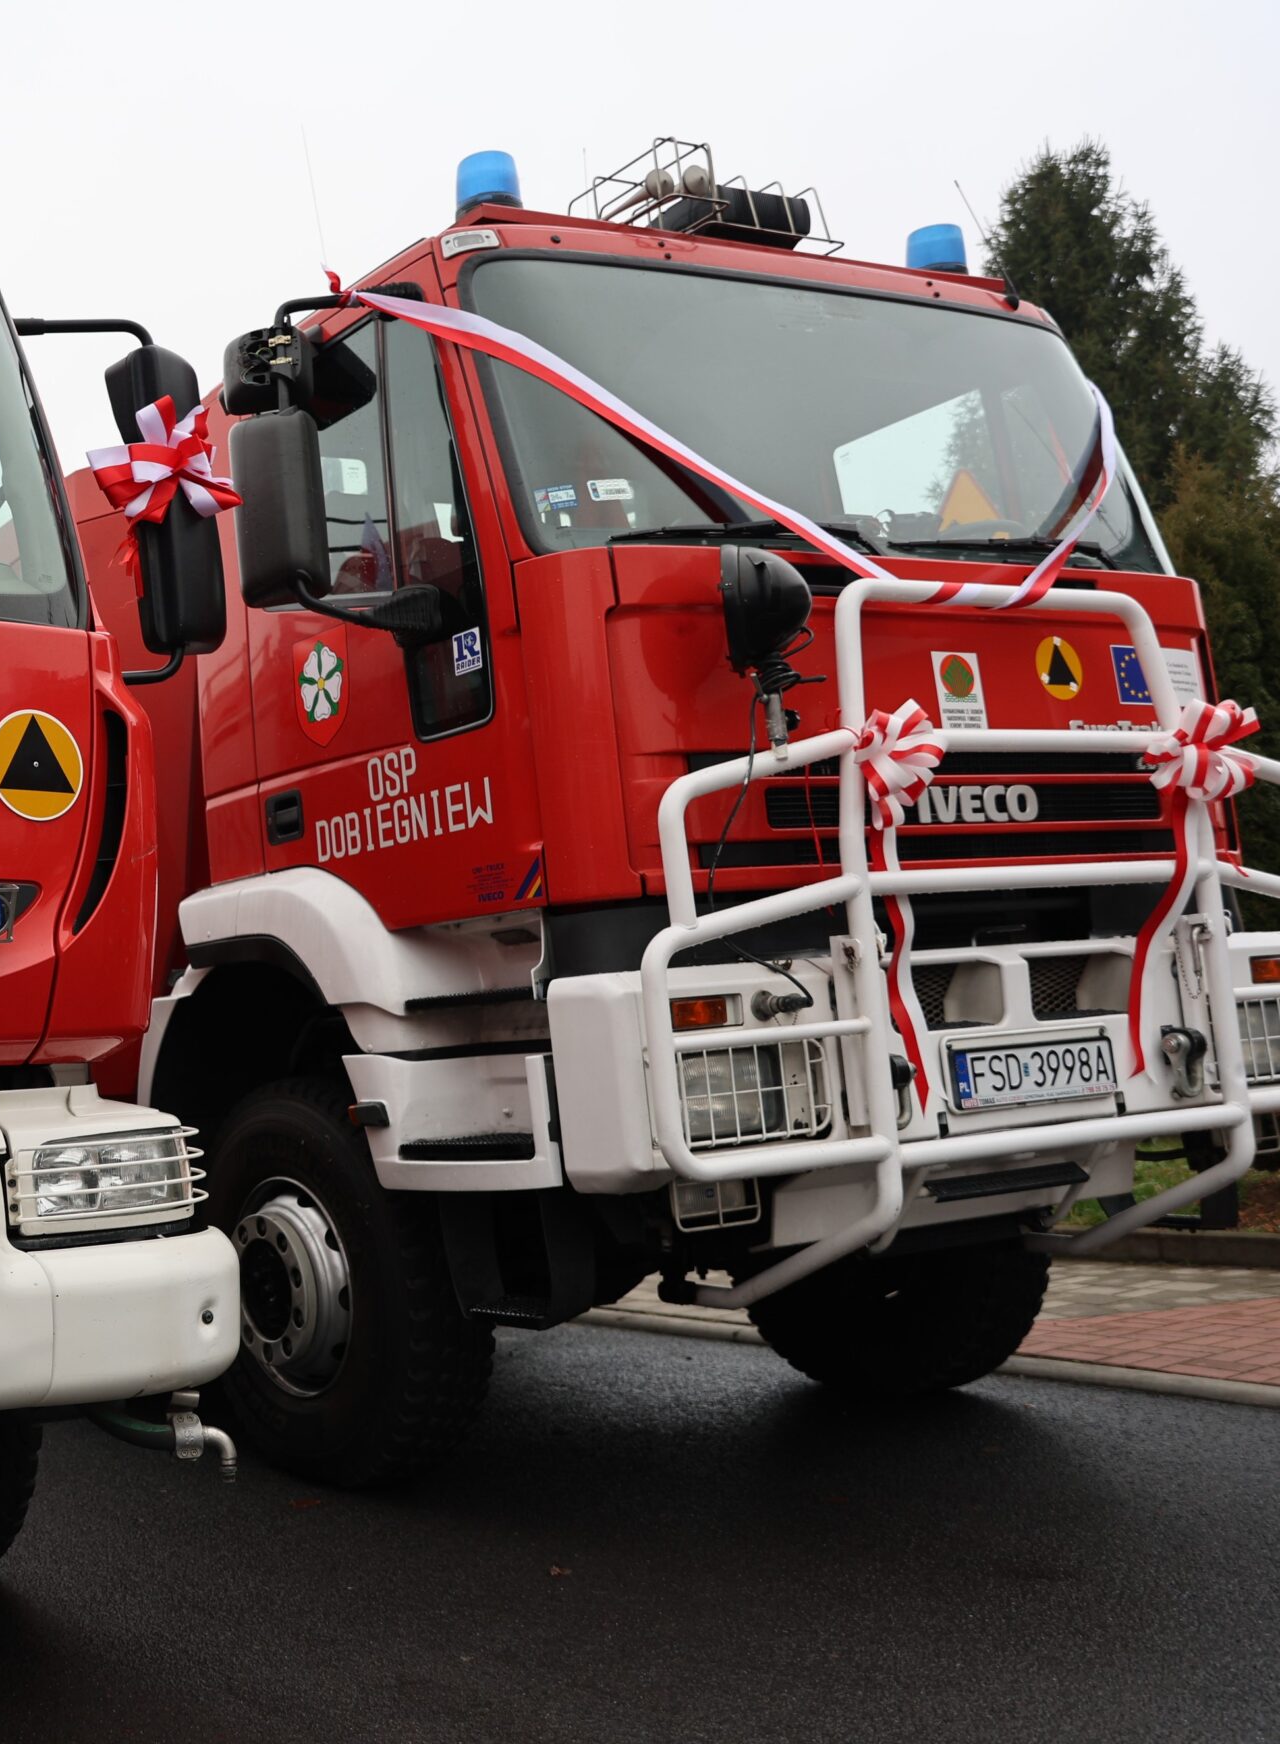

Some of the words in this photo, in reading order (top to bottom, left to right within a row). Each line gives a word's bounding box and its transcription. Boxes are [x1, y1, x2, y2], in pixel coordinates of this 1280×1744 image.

[456, 655, 481, 671] RAIDER
[367, 747, 417, 801] OSP
[315, 776, 494, 863] DOBIEGNIEW
[917, 784, 1039, 824] IVECO
[478, 891, 505, 903] IVECO
[959, 1081, 970, 1093] PL
[970, 1053, 1023, 1094] FSD
[1030, 1045, 1111, 1088] 3998A
